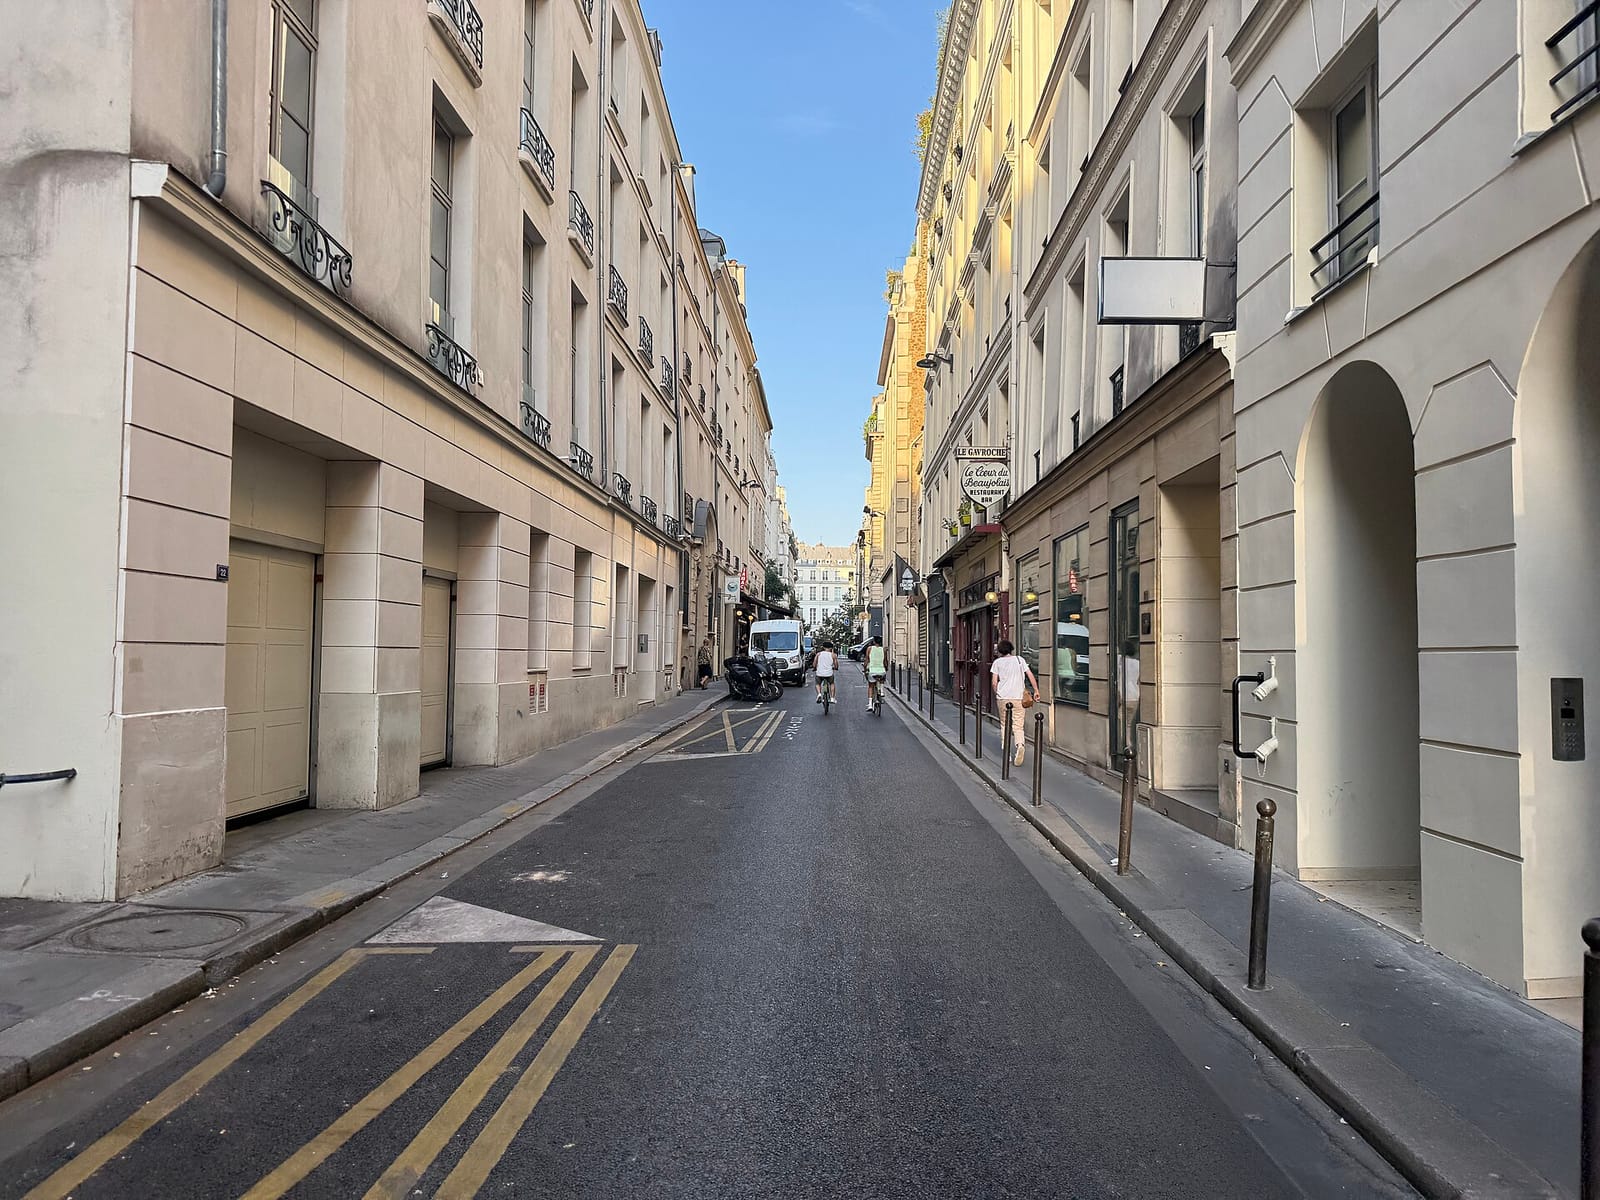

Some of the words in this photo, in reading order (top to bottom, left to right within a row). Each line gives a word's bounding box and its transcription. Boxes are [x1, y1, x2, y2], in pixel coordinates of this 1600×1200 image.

[957, 448, 967, 456] LE
[968, 448, 1006, 456] GAVROCHE
[998, 467, 1009, 477] du
[963, 477, 1010, 489] Beaujolais
